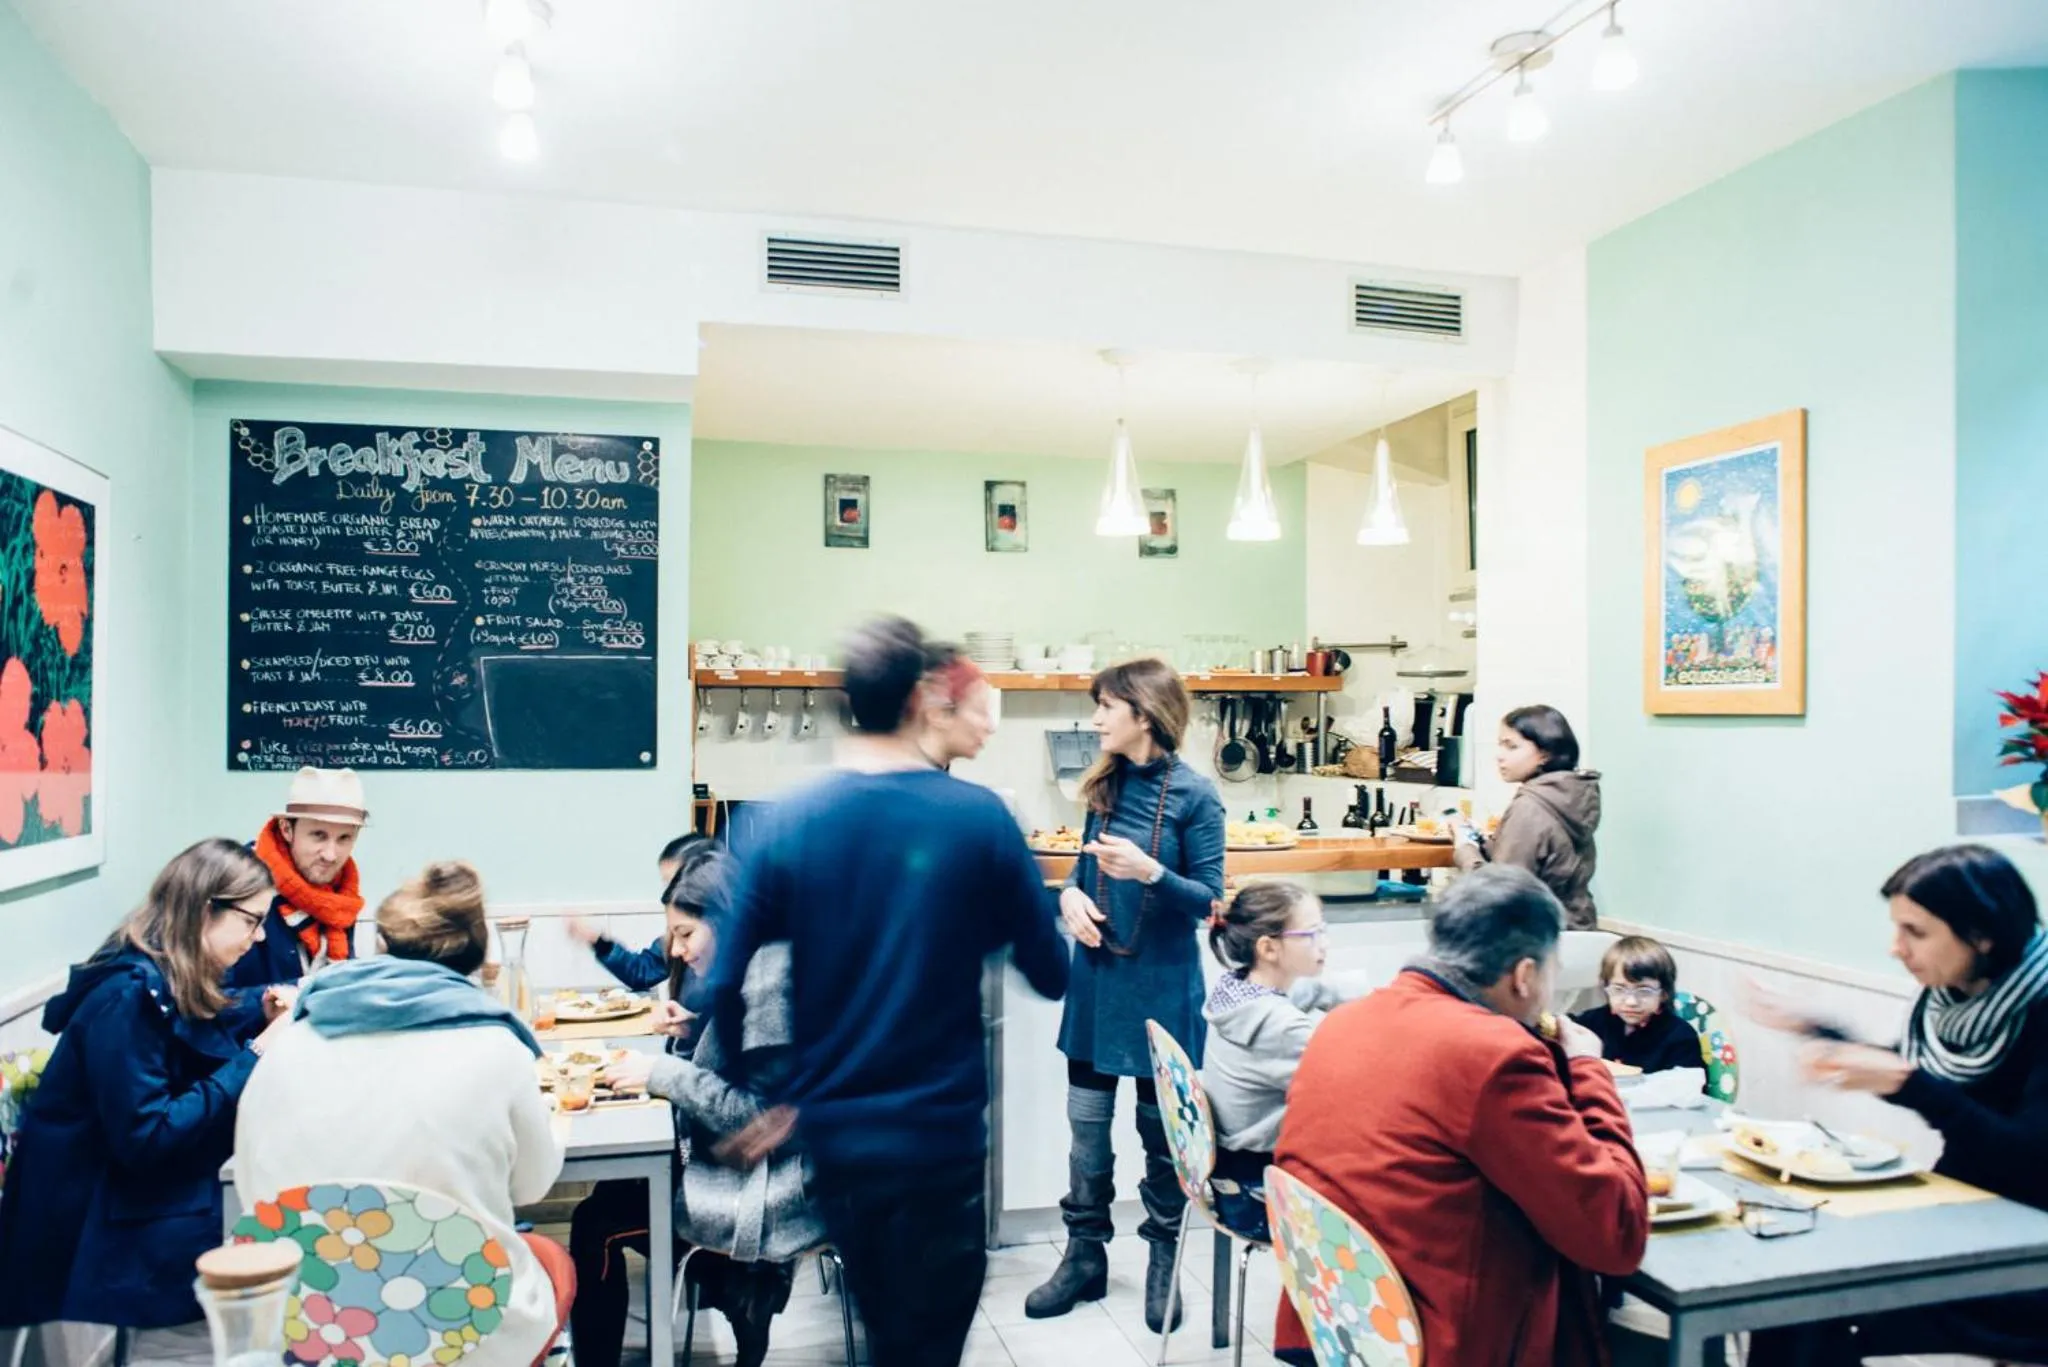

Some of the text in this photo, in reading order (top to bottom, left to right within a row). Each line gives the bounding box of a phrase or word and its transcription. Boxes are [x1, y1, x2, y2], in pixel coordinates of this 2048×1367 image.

[271, 426, 631, 492] Breakfast Menu
[336, 475, 396, 515] Daily
[411, 477, 457, 513] from
[464, 483, 515, 508] 7.30
[332, 513, 395, 526] ORGANIC
[399, 516, 440, 530] BREAD
[345, 526, 393, 536] BUTTER
[250, 578, 280, 592] WITH
[486, 614, 564, 629] FRUIT SALAD
